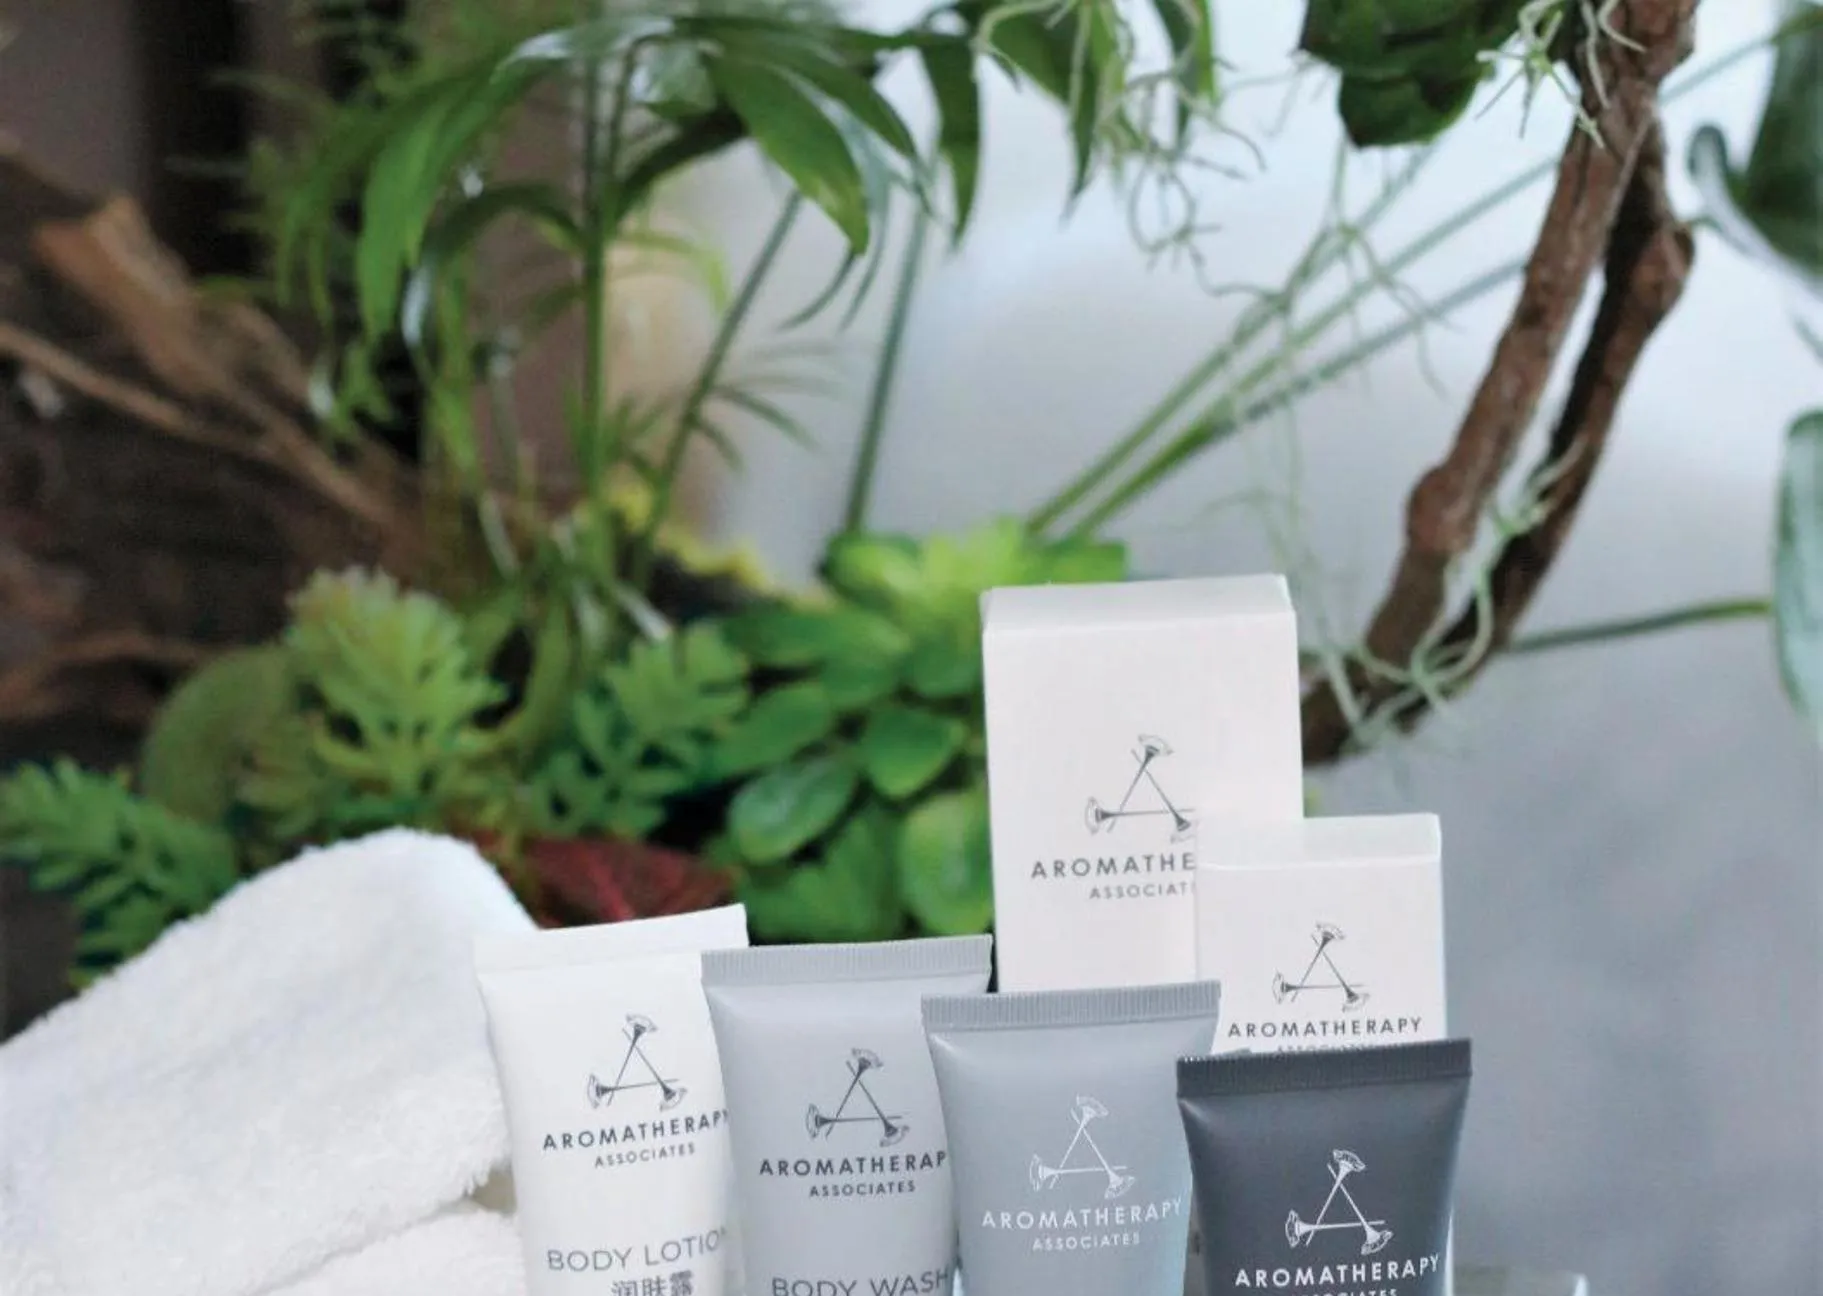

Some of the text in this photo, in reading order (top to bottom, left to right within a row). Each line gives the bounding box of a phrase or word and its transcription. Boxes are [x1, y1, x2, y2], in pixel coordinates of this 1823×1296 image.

[1089, 881, 1196, 899] ASSOCIAT
[1228, 1017, 1422, 1038] AROMATHERAPY
[595, 1142, 695, 1168] ASSOCIATES
[809, 1180, 916, 1197] ASSOCIATES
[982, 1197, 1182, 1230] AROMATHERAPY
[547, 1226, 726, 1271] BODY LOTIO
[1032, 1231, 1140, 1252] ASSOCIATES
[1235, 1253, 1440, 1288] AROMATHERAPY
